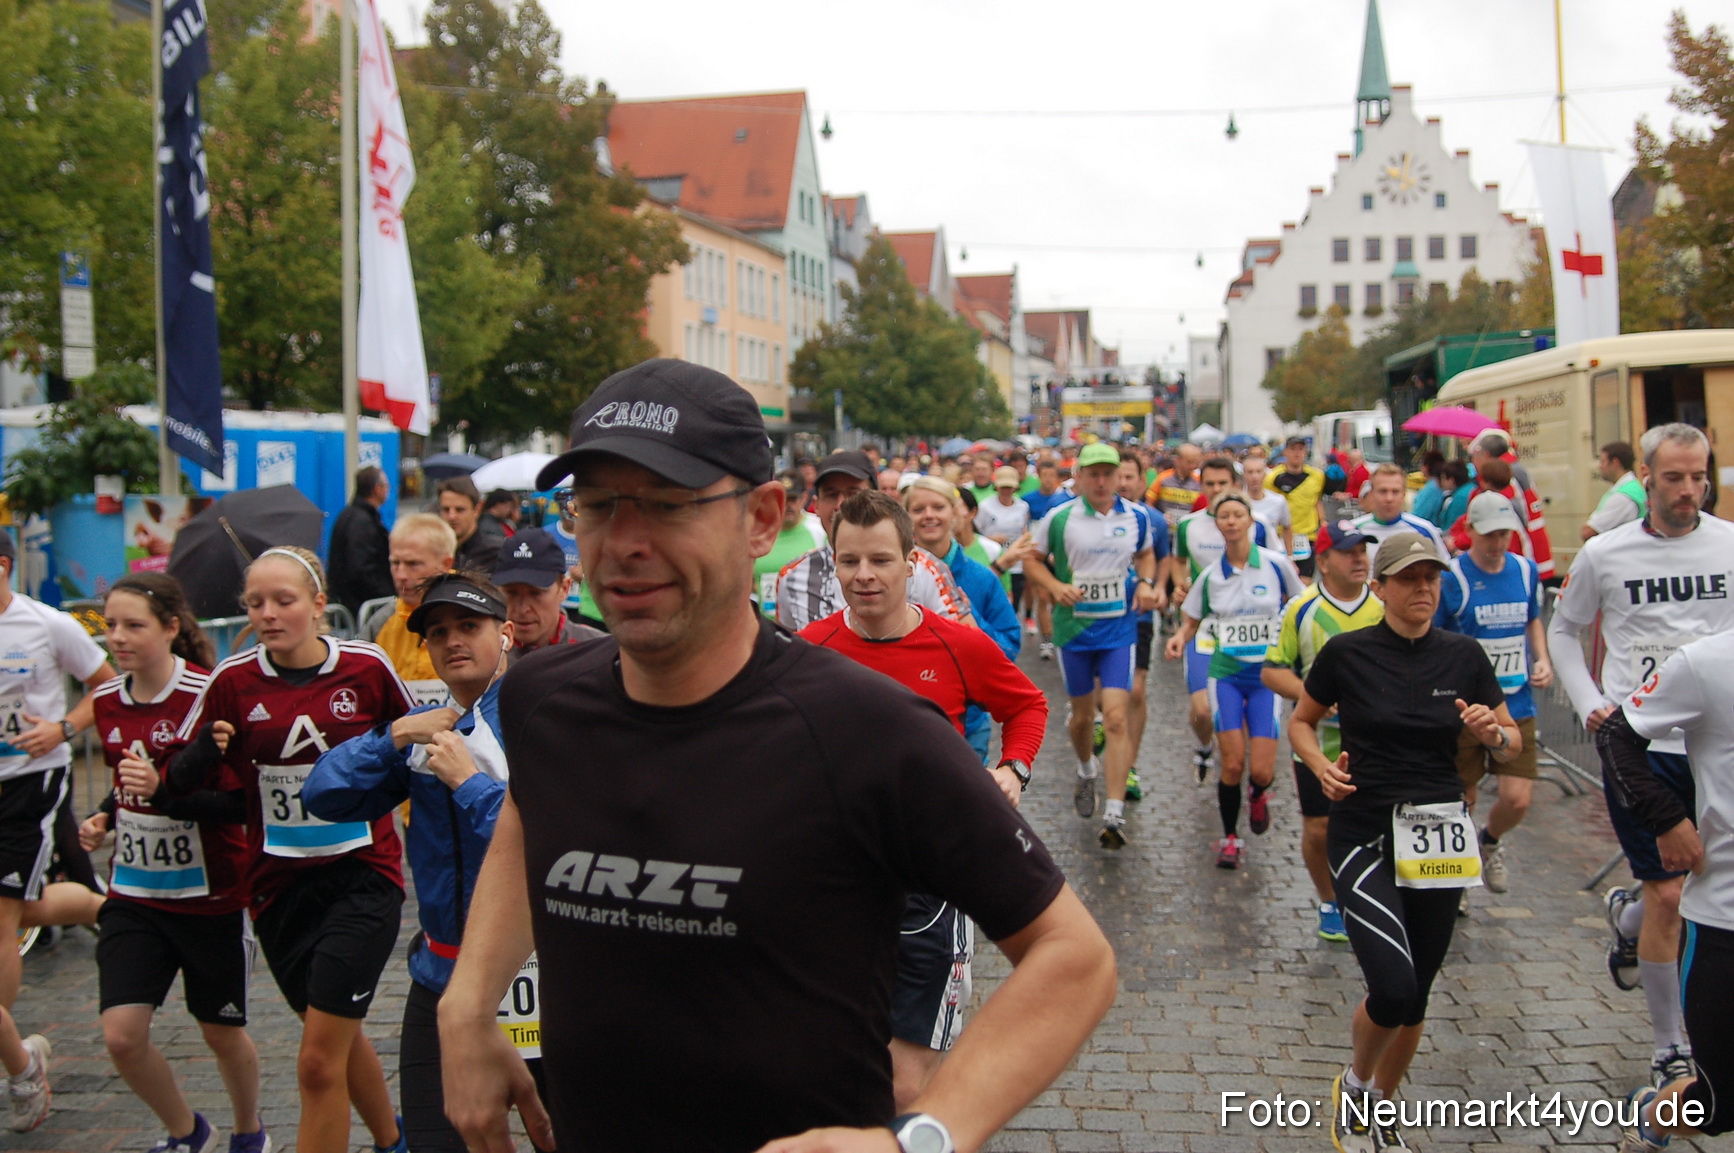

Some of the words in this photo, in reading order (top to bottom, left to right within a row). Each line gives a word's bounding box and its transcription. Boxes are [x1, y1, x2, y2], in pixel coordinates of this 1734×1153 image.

[612, 420, 675, 434] INNOVATIONS
[457, 591, 487, 604] 2XU
[1079, 582, 1119, 600] 2811
[1624, 574, 1727, 605] THULE
[1226, 624, 1269, 643] 2804
[333, 701, 356, 713] FCN
[262, 775, 291, 784] PARTL
[1411, 823, 1466, 853] 318
[123, 832, 193, 866] 3148
[1419, 863, 1462, 876] Kristina
[545, 850, 743, 909] ARZT
[545, 898, 737, 936] www.arzt-reisen.de
[510, 1028, 540, 1043] Tim
